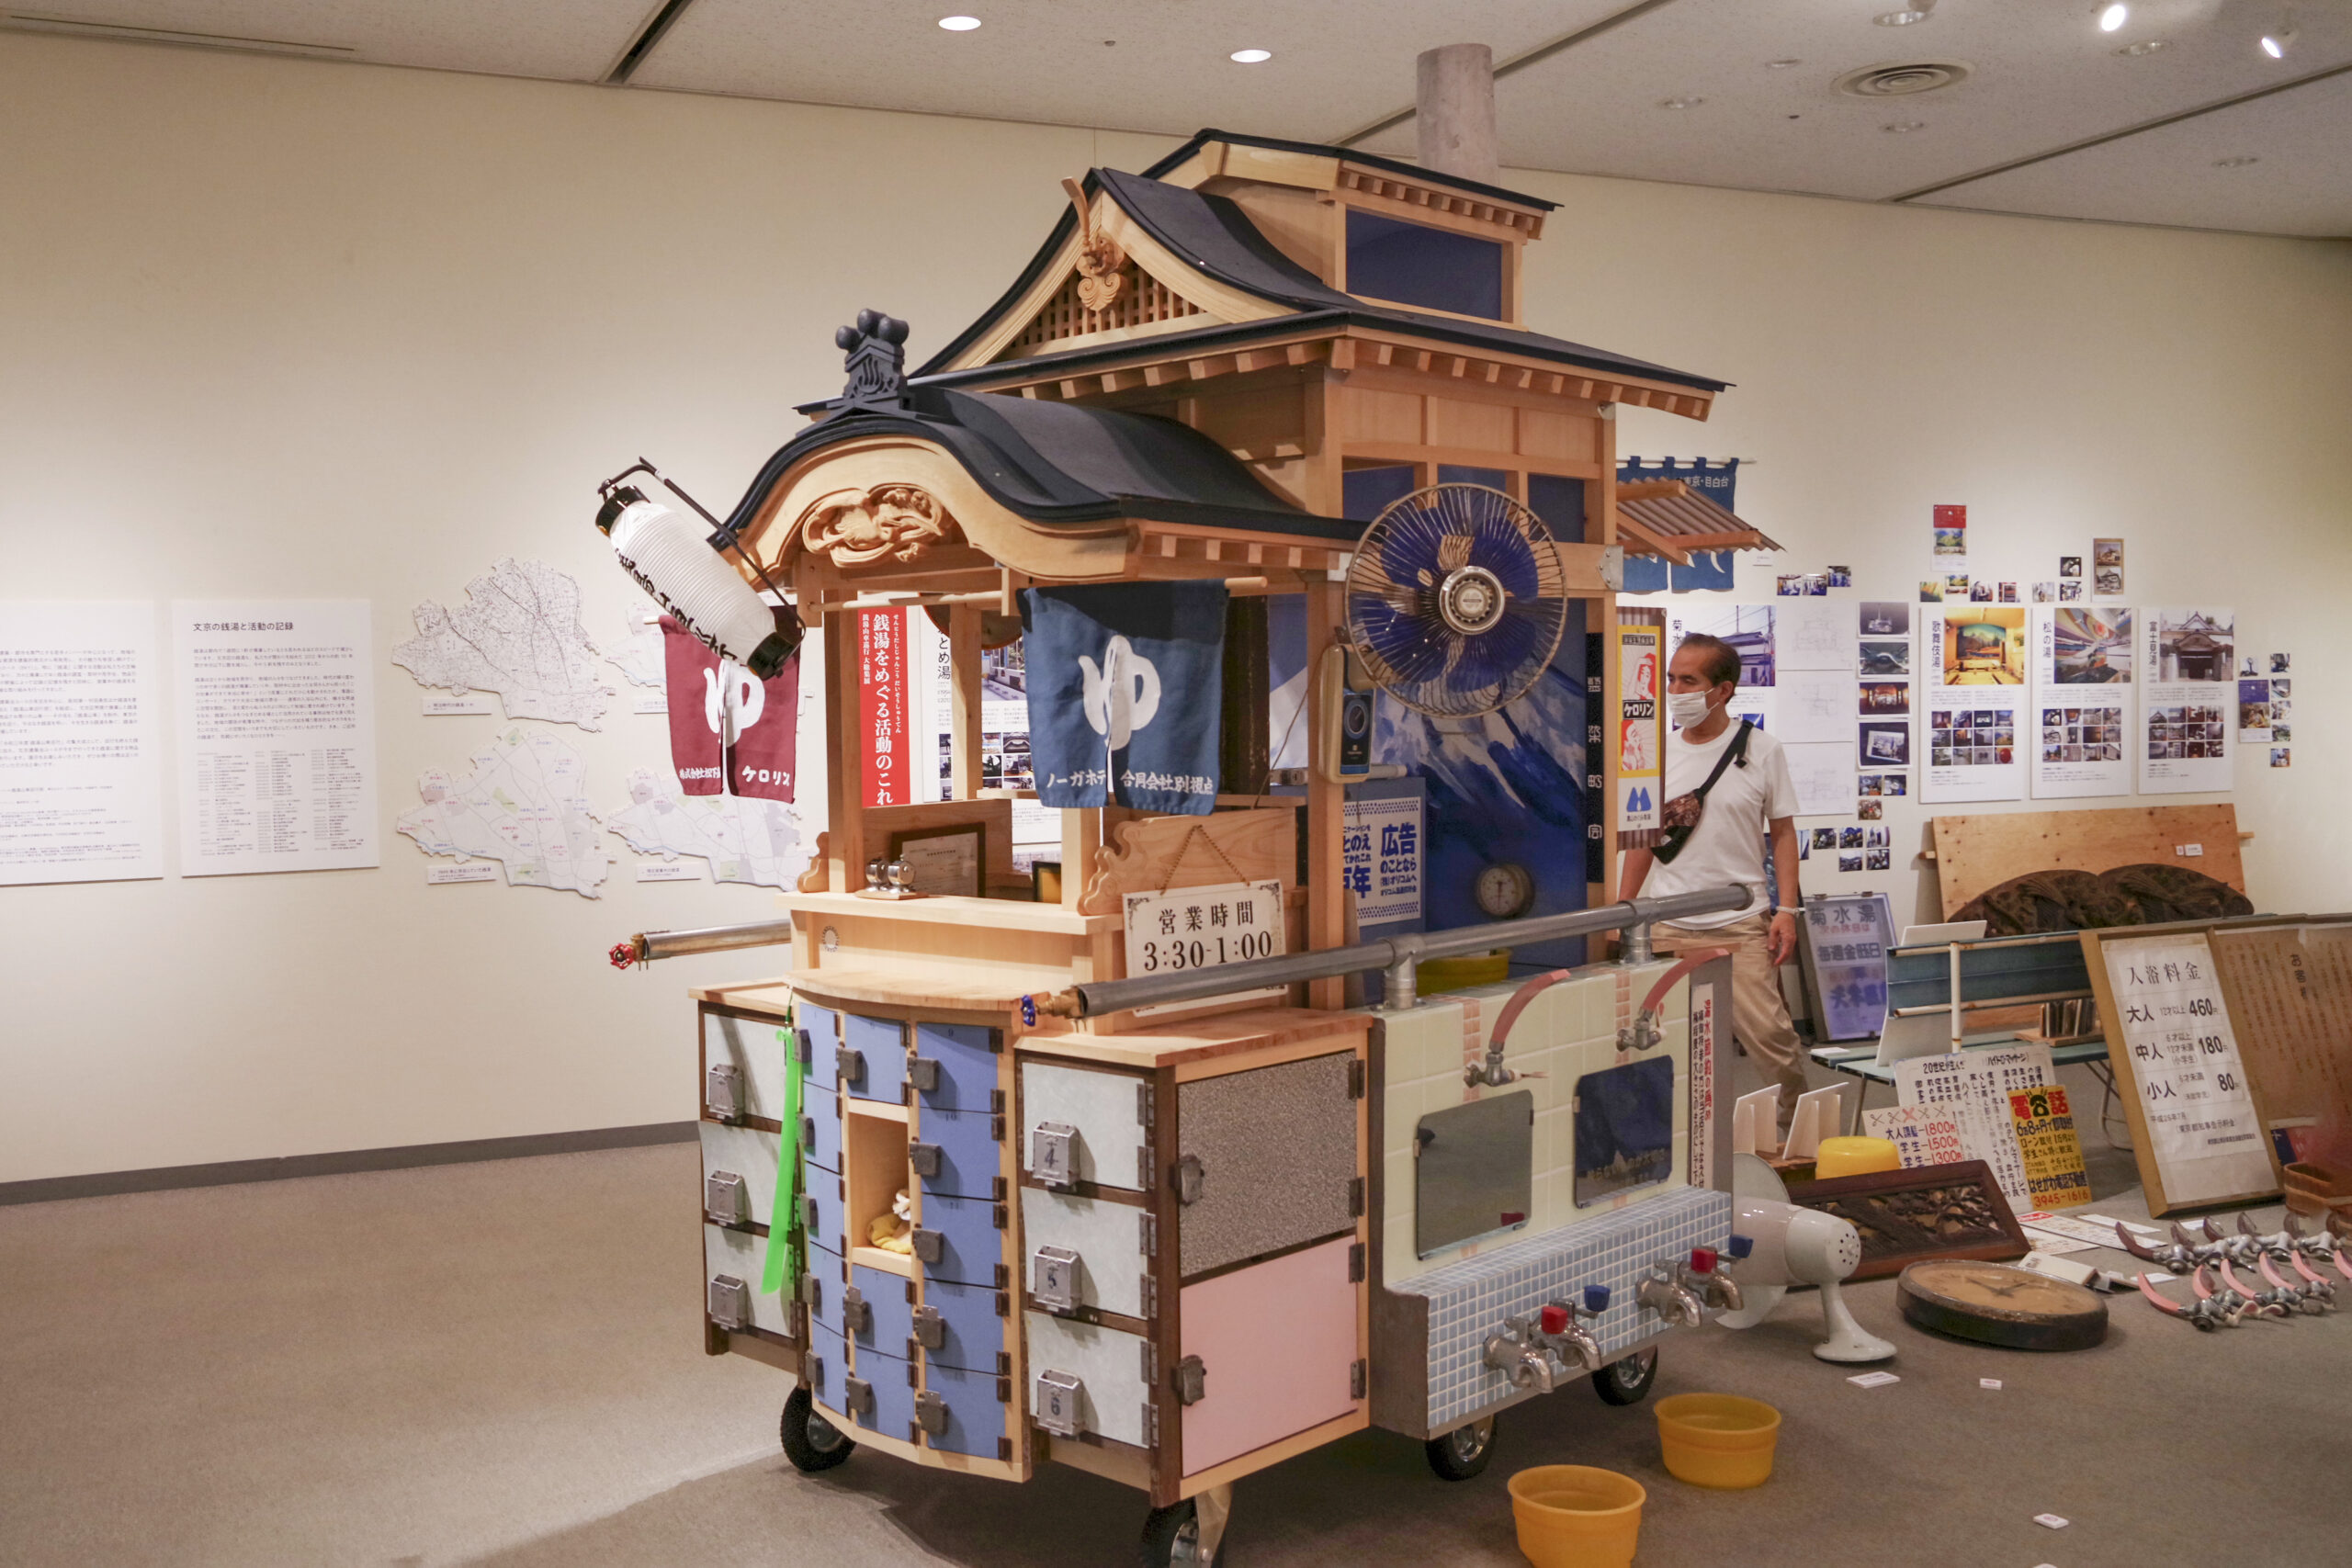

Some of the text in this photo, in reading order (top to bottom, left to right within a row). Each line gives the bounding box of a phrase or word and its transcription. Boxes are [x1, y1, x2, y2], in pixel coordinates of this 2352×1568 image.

[193, 622, 294, 632] 文京の銭湯と活動の記録
[2042, 622, 2052, 658] 松の湯
[703, 659, 766, 748] ゆ
[1078, 635, 1161, 751] ゆ
[873, 614, 893, 806] 銭湯をめぐる活動のこれ
[1623, 703, 1654, 717] ケロリン
[742, 765, 791, 786] ケロリン
[1120, 769, 1214, 795] 合同会社別視点
[1380, 822, 1417, 857] 広告
[1380, 857, 1417, 874] のことなら
[1159, 900, 1253, 935] 営業時間
[1810, 904, 1876, 926] 菊水湯
[2126, 962, 2201, 985] 入浴料金
[2126, 1004, 2154, 1023] 大人
[2135, 1043, 2164, 1061] 中人
[2147, 1080, 2177, 1100] 小人
[2010, 1090, 2069, 1120] 電 話
[2033, 1190, 2088, 1207] 3945-1616
